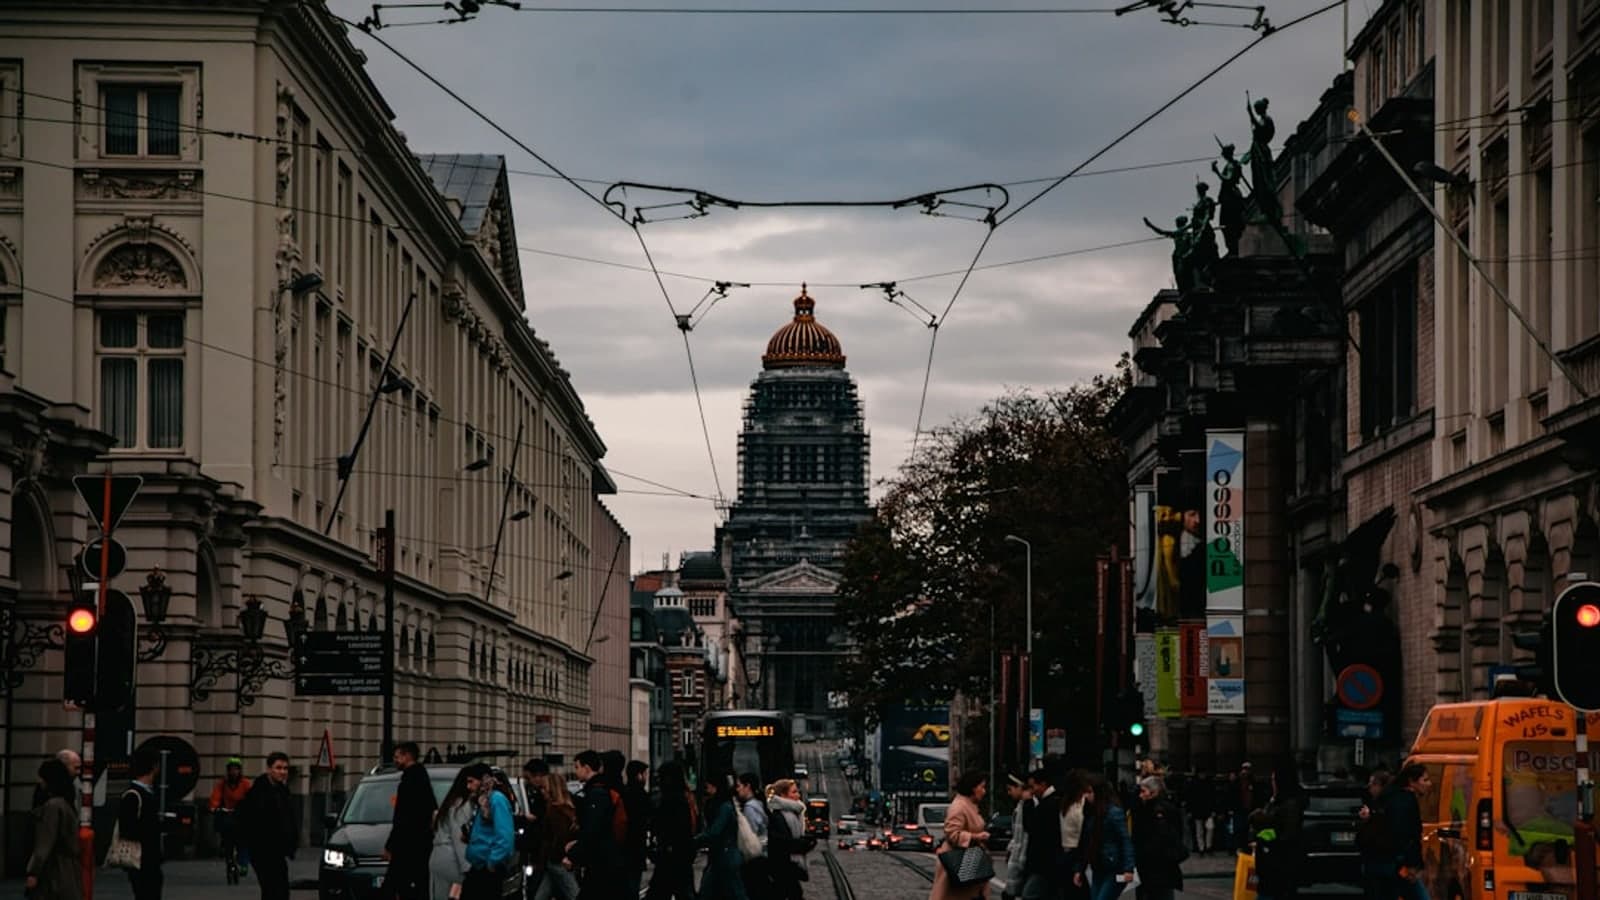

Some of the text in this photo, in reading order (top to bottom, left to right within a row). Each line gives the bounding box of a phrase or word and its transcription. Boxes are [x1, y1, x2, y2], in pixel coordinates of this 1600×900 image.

[1211, 469, 1231, 577] Picasso
[1503, 705, 1565, 727] WAFELS
[1522, 723, 1548, 738] IJS
